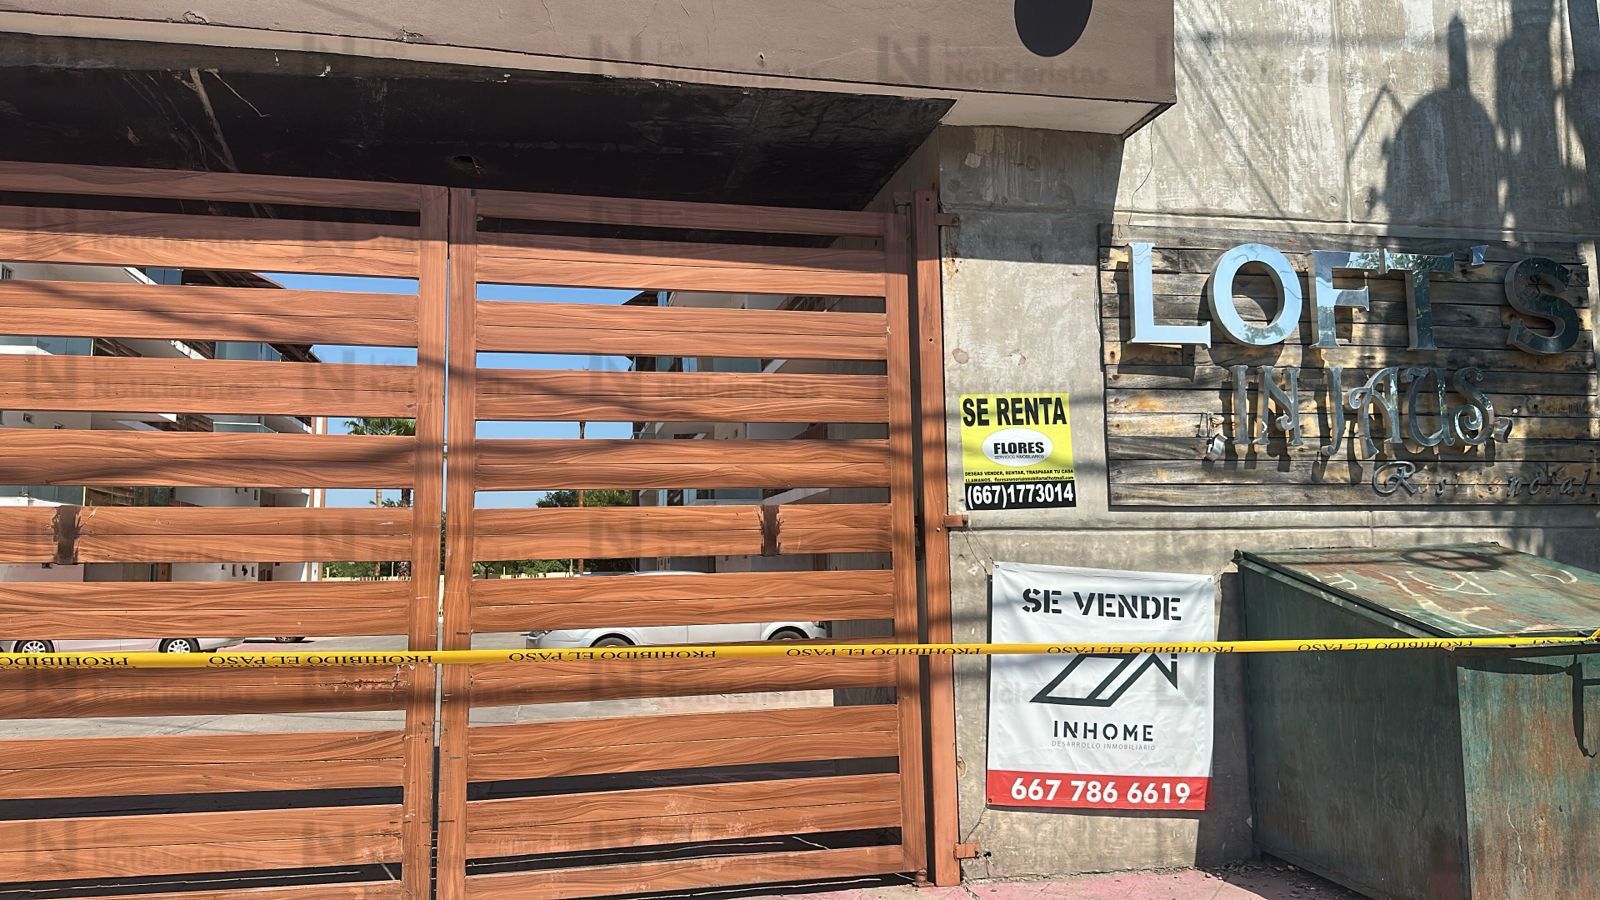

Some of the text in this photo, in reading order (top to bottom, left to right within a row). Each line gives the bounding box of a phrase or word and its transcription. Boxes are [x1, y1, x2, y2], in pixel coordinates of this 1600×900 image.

[1127, 241, 1580, 354] LOFT'S
[962, 397, 1067, 427] SE RENTA
[993, 441, 1044, 455] FLORES
[967, 483, 1073, 509] (667)1773014
[1022, 588, 1182, 621] SE VENDE
[600, 650, 716, 660] PROHIBIDO
[787, 648, 836, 657] PASO
[871, 647, 982, 656] PROHIBIDO
[1047, 646, 1096, 654] PASO
[1129, 645, 1234, 654] PROHIBIDO
[208, 656, 266, 666] PASO
[307, 655, 432, 664] PROHIBIDO
[508, 652, 562, 662] PASO
[1053, 720, 1154, 742] INHOME
[1051, 740, 1156, 752] DESARROLLO INMOBILIARIO
[1010, 778, 1191, 804] 667 786 6619
